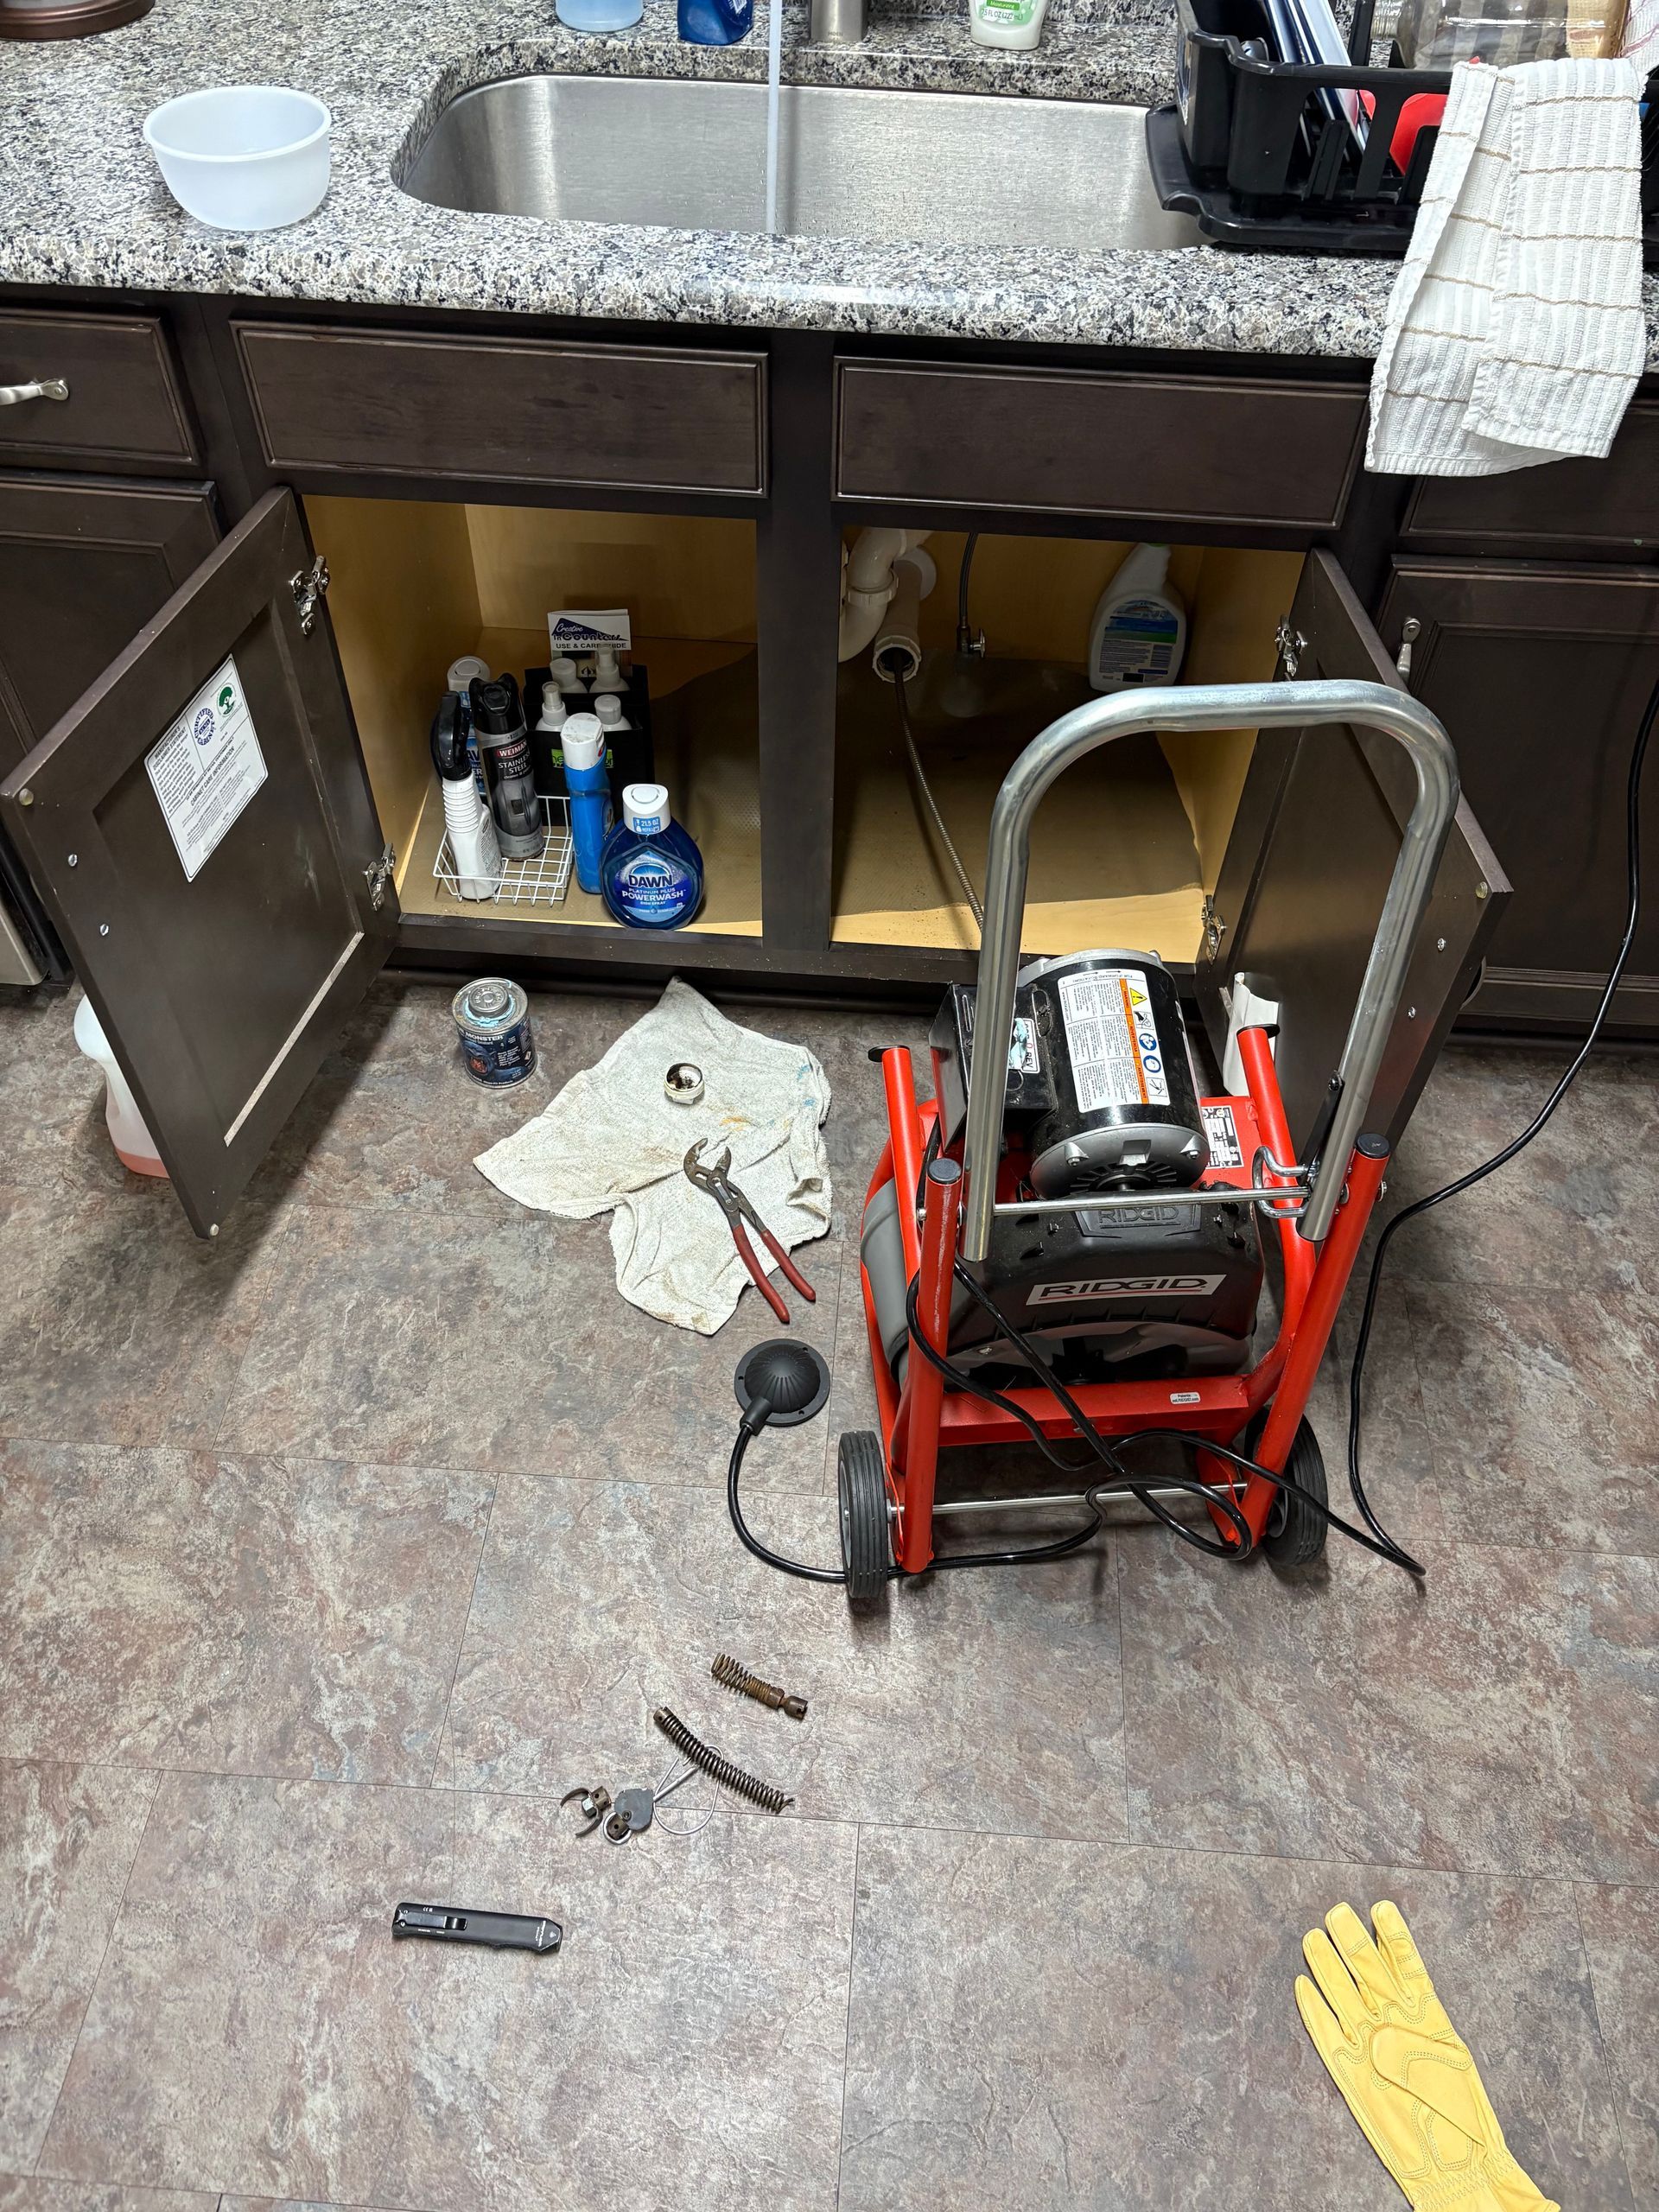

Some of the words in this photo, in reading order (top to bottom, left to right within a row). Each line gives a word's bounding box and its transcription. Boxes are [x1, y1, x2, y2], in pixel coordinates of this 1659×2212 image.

[509, 762, 528, 774] STEEL
[190, 785, 204, 806] CABINET
[212, 746, 235, 777] INFORMATION
[629, 874, 672, 887] DAWN
[622, 890, 683, 902] POWERWASH
[465, 1032, 503, 1041] MONSTER
[1025, 1052, 1033, 1068] REV
[1098, 1205, 1179, 1224] RIDGID
[1040, 1278, 1207, 1298] RIDGID
